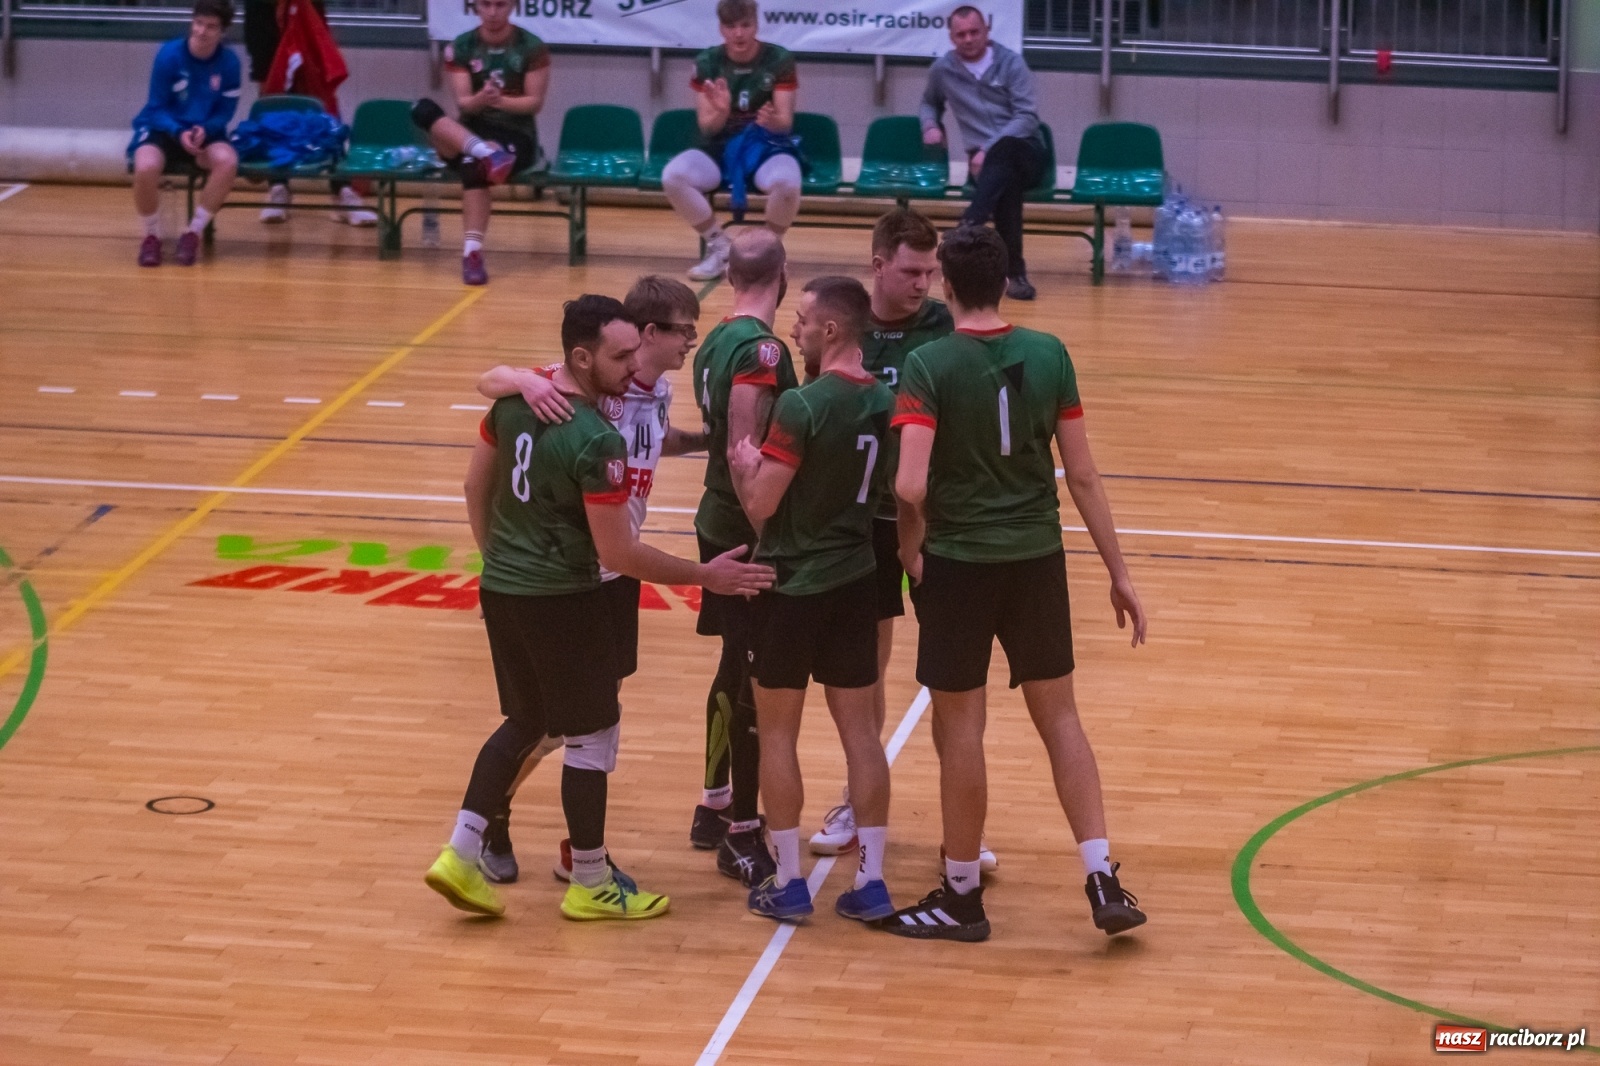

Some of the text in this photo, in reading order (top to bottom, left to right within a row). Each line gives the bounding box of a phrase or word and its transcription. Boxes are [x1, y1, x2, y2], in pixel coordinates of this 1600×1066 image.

[464, 0, 593, 18] RIBORZ
[764, 9, 993, 31] www.osir-racibol
[998, 386, 1011, 456] 1
[634, 423, 651, 461] 14
[511, 432, 533, 503] 8
[856, 434, 879, 504] 7
[859, 844, 867, 873] FILA
